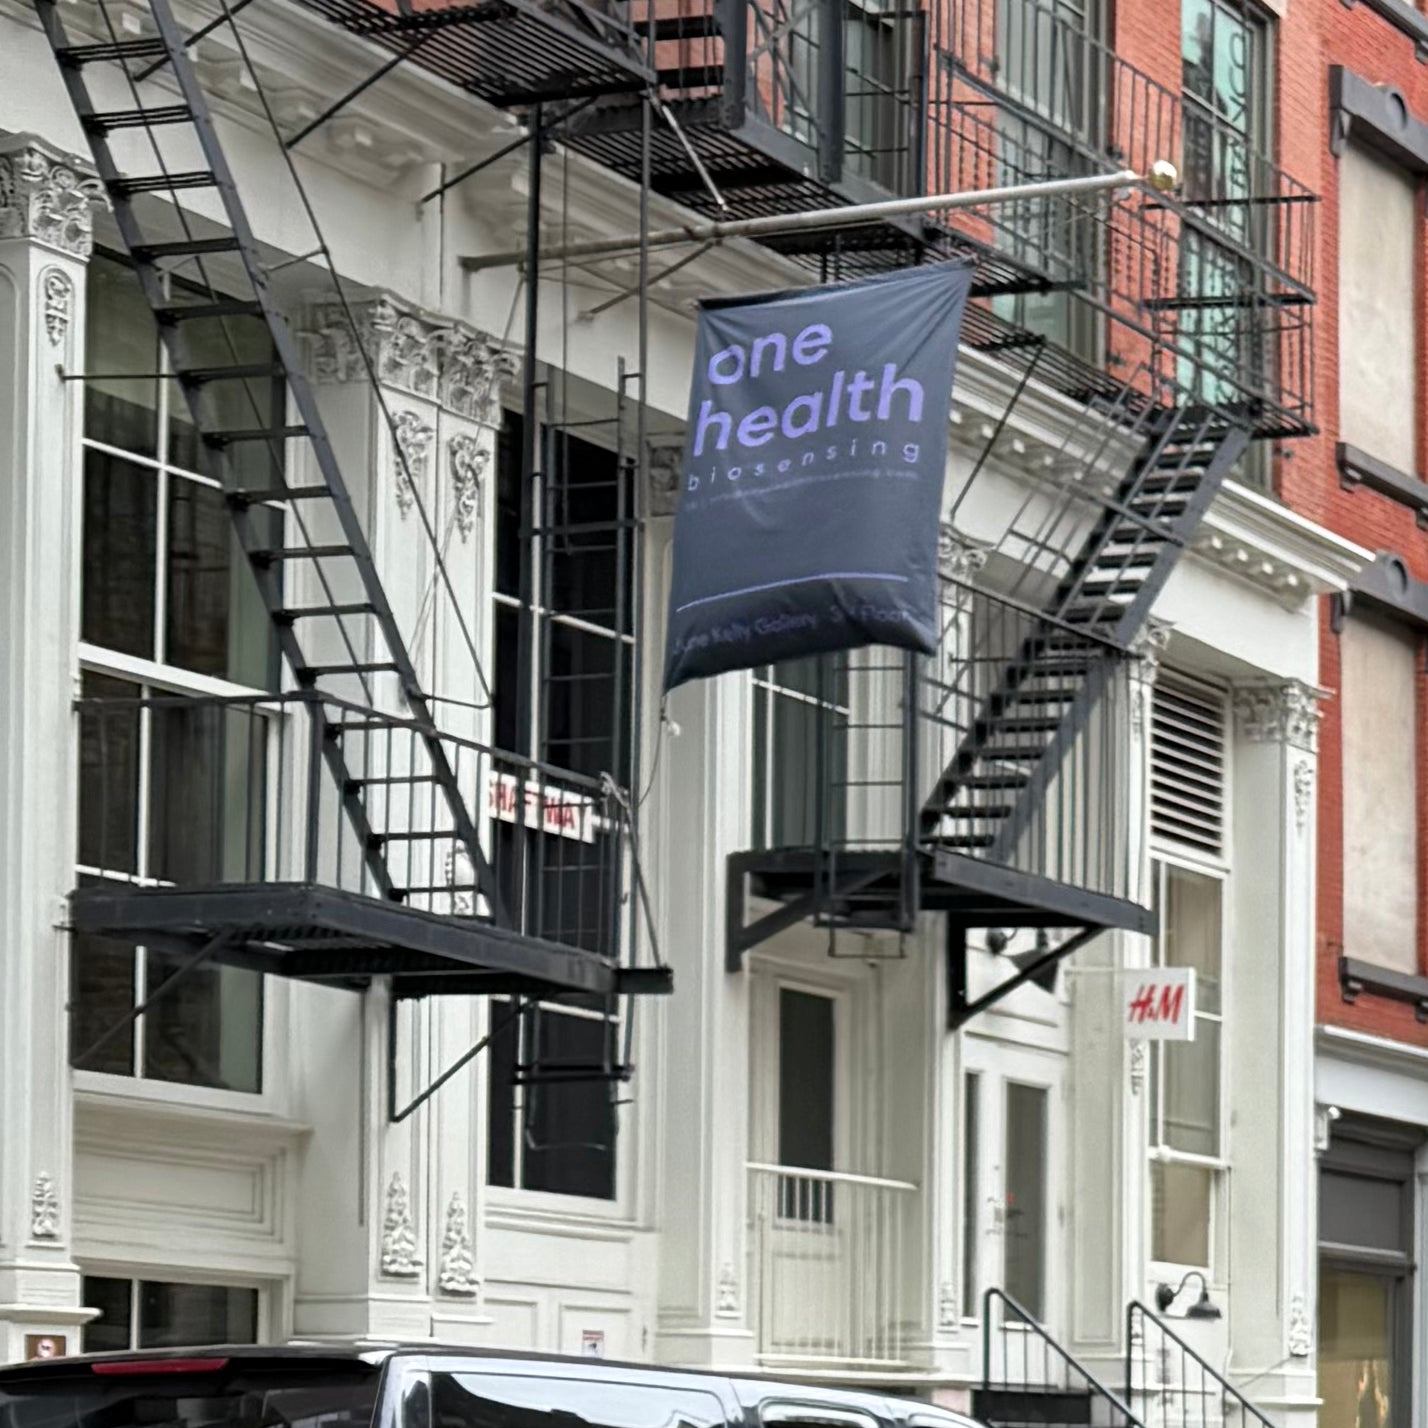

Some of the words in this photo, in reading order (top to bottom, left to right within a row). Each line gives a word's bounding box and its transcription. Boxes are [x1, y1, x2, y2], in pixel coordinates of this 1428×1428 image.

[708, 323, 833, 385] one
[693, 363, 924, 457] health
[687, 438, 920, 491] biosensing
[1127, 984, 1185, 1024] H&M
